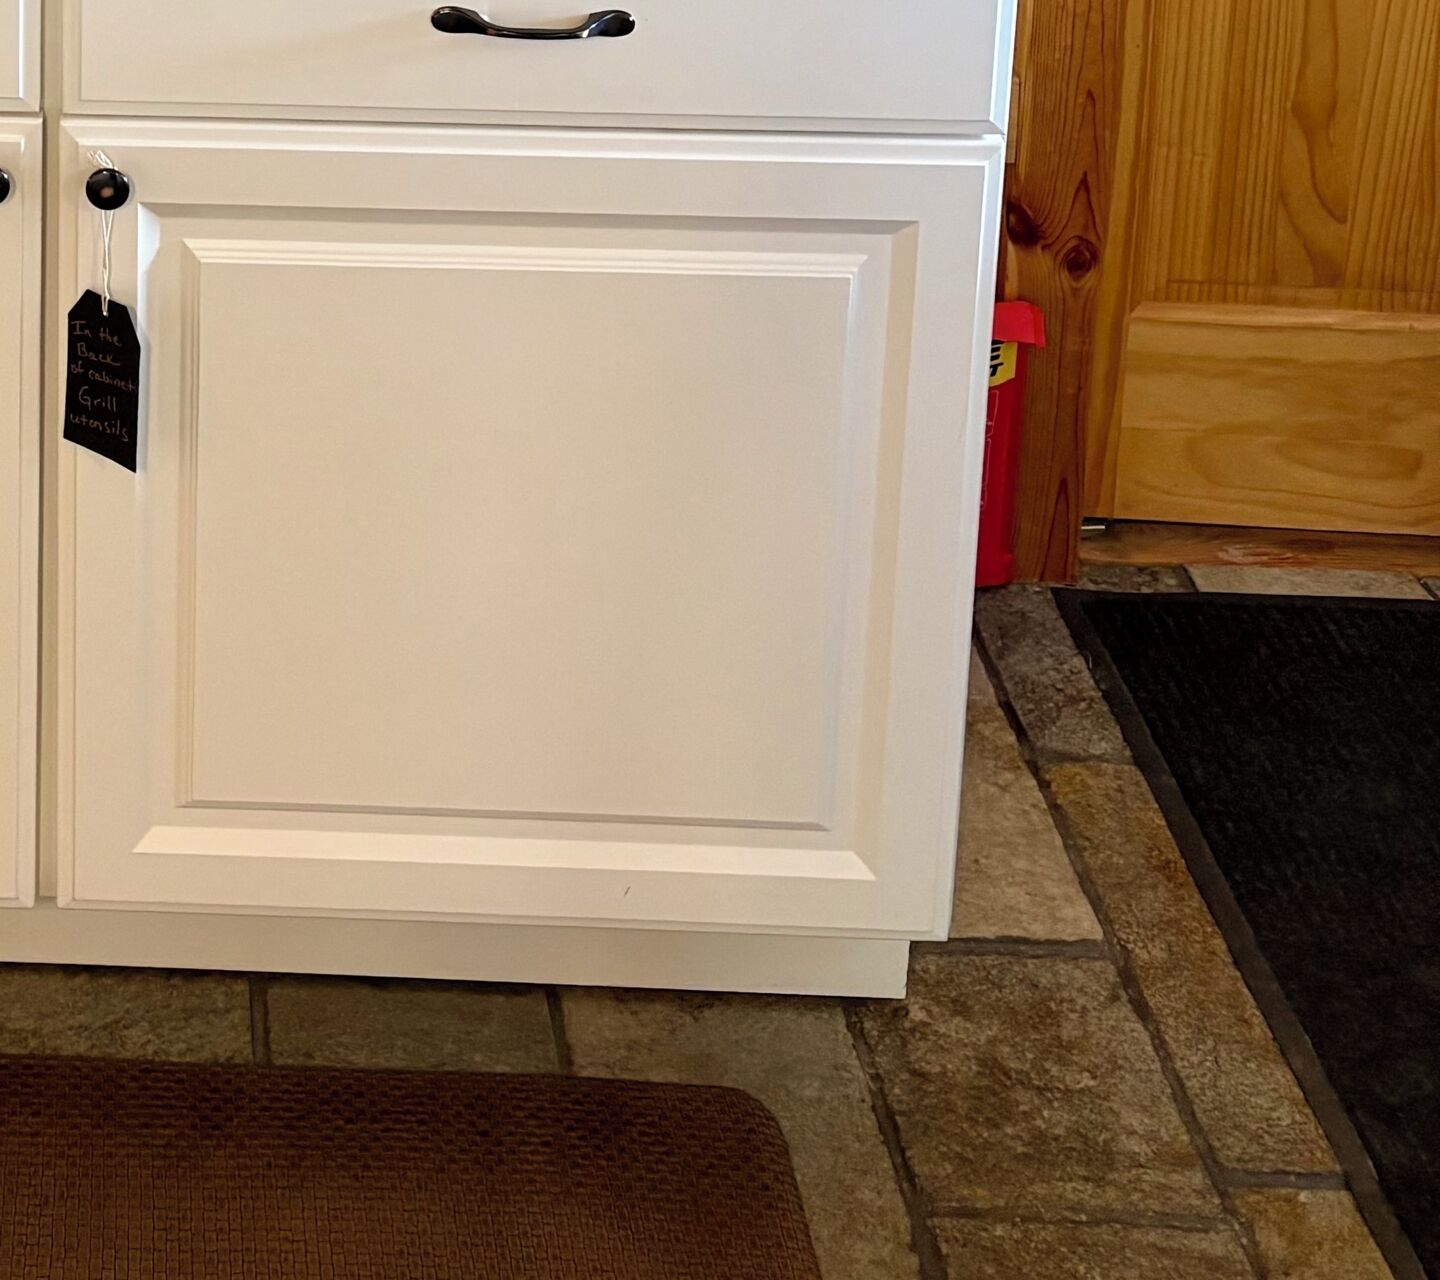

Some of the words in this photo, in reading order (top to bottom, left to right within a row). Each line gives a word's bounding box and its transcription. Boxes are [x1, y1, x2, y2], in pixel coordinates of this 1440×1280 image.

[71, 320, 92, 338] In
[99, 327, 123, 347] the
[77, 342, 121, 366] Back
[71, 362, 85, 375] of
[78, 386, 117, 413] Grill
[69, 412, 129, 442] utensils
